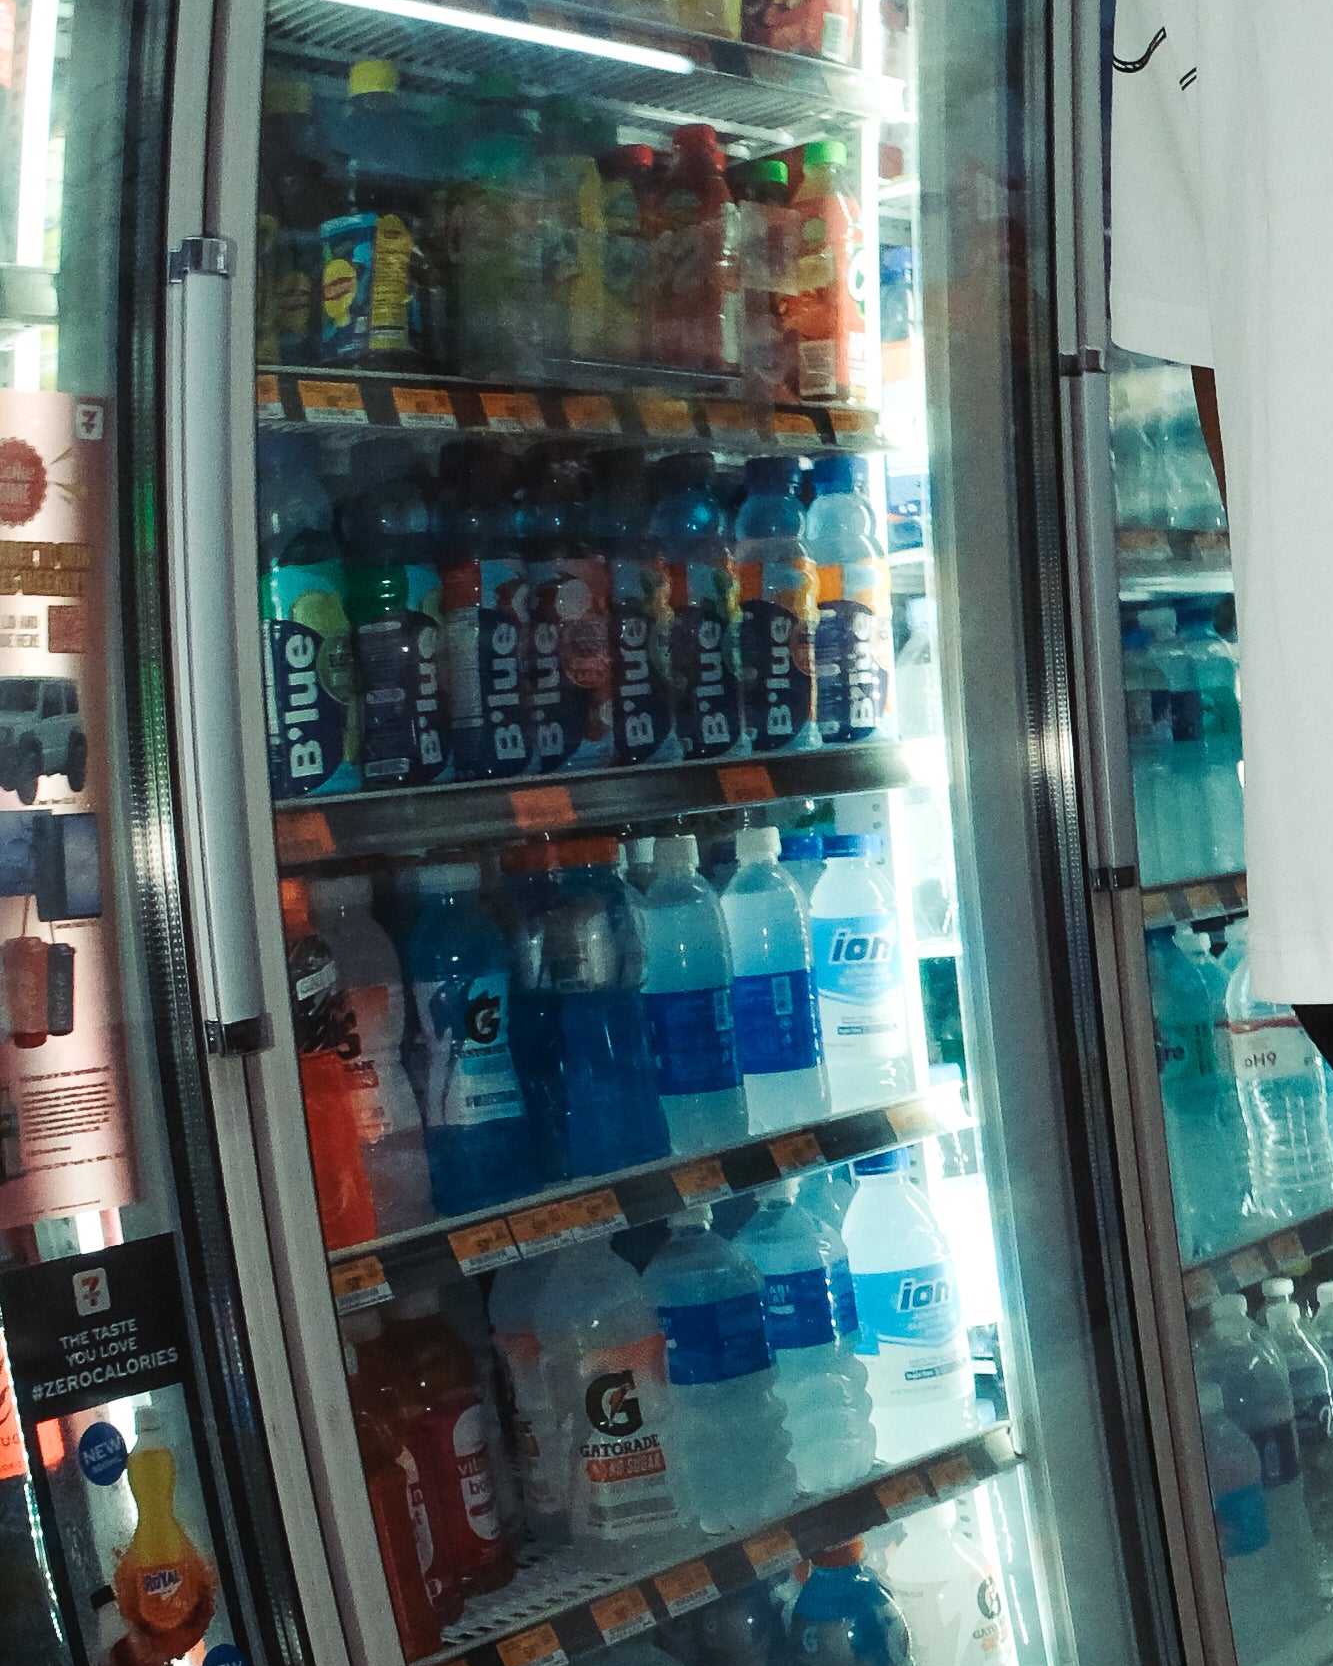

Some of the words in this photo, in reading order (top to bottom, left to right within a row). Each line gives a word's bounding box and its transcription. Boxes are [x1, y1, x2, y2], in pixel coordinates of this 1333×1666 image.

[488, 623, 526, 759] B'lue
[620, 618, 654, 747] B'lue
[696, 621, 729, 743] B'lue
[767, 616, 793, 734] B'lue
[285, 635, 323, 778] B'lue
[830, 930, 890, 963] ion
[59, 1332, 91, 1350] THE
[94, 1318, 139, 1343] TASTE
[65, 1348, 96, 1368] YOU
[100, 1337, 138, 1359] LOVE
[32, 1347, 178, 1401] #ZEROCALORIES
[585, 1370, 643, 1437] G
[83, 1439, 122, 1464] NEW
[580, 1435, 660, 1457] GATORADE
